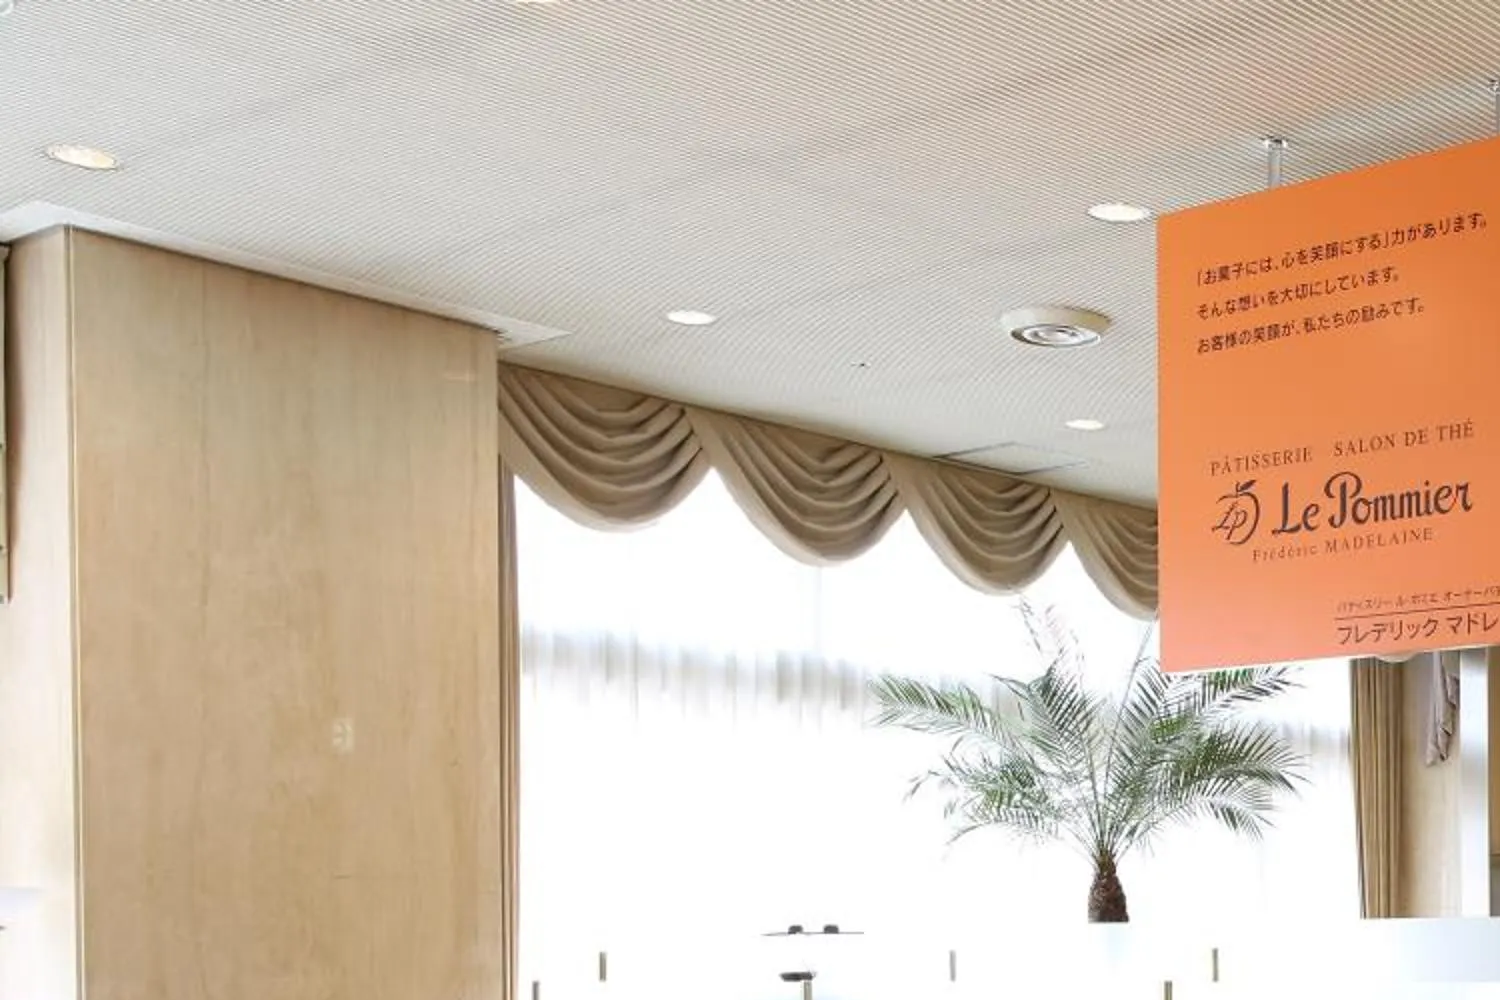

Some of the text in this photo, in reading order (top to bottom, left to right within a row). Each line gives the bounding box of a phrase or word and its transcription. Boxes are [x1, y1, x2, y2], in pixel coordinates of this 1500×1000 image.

[1333, 433, 1396, 458] SALON
[1402, 427, 1430, 448] DE
[1435, 417, 1475, 443] THÉ
[1271, 470, 1474, 536] Le Pommier
[1324, 527, 1434, 554] MADELAINE
[1336, 617, 1440, 646] フレデリック
